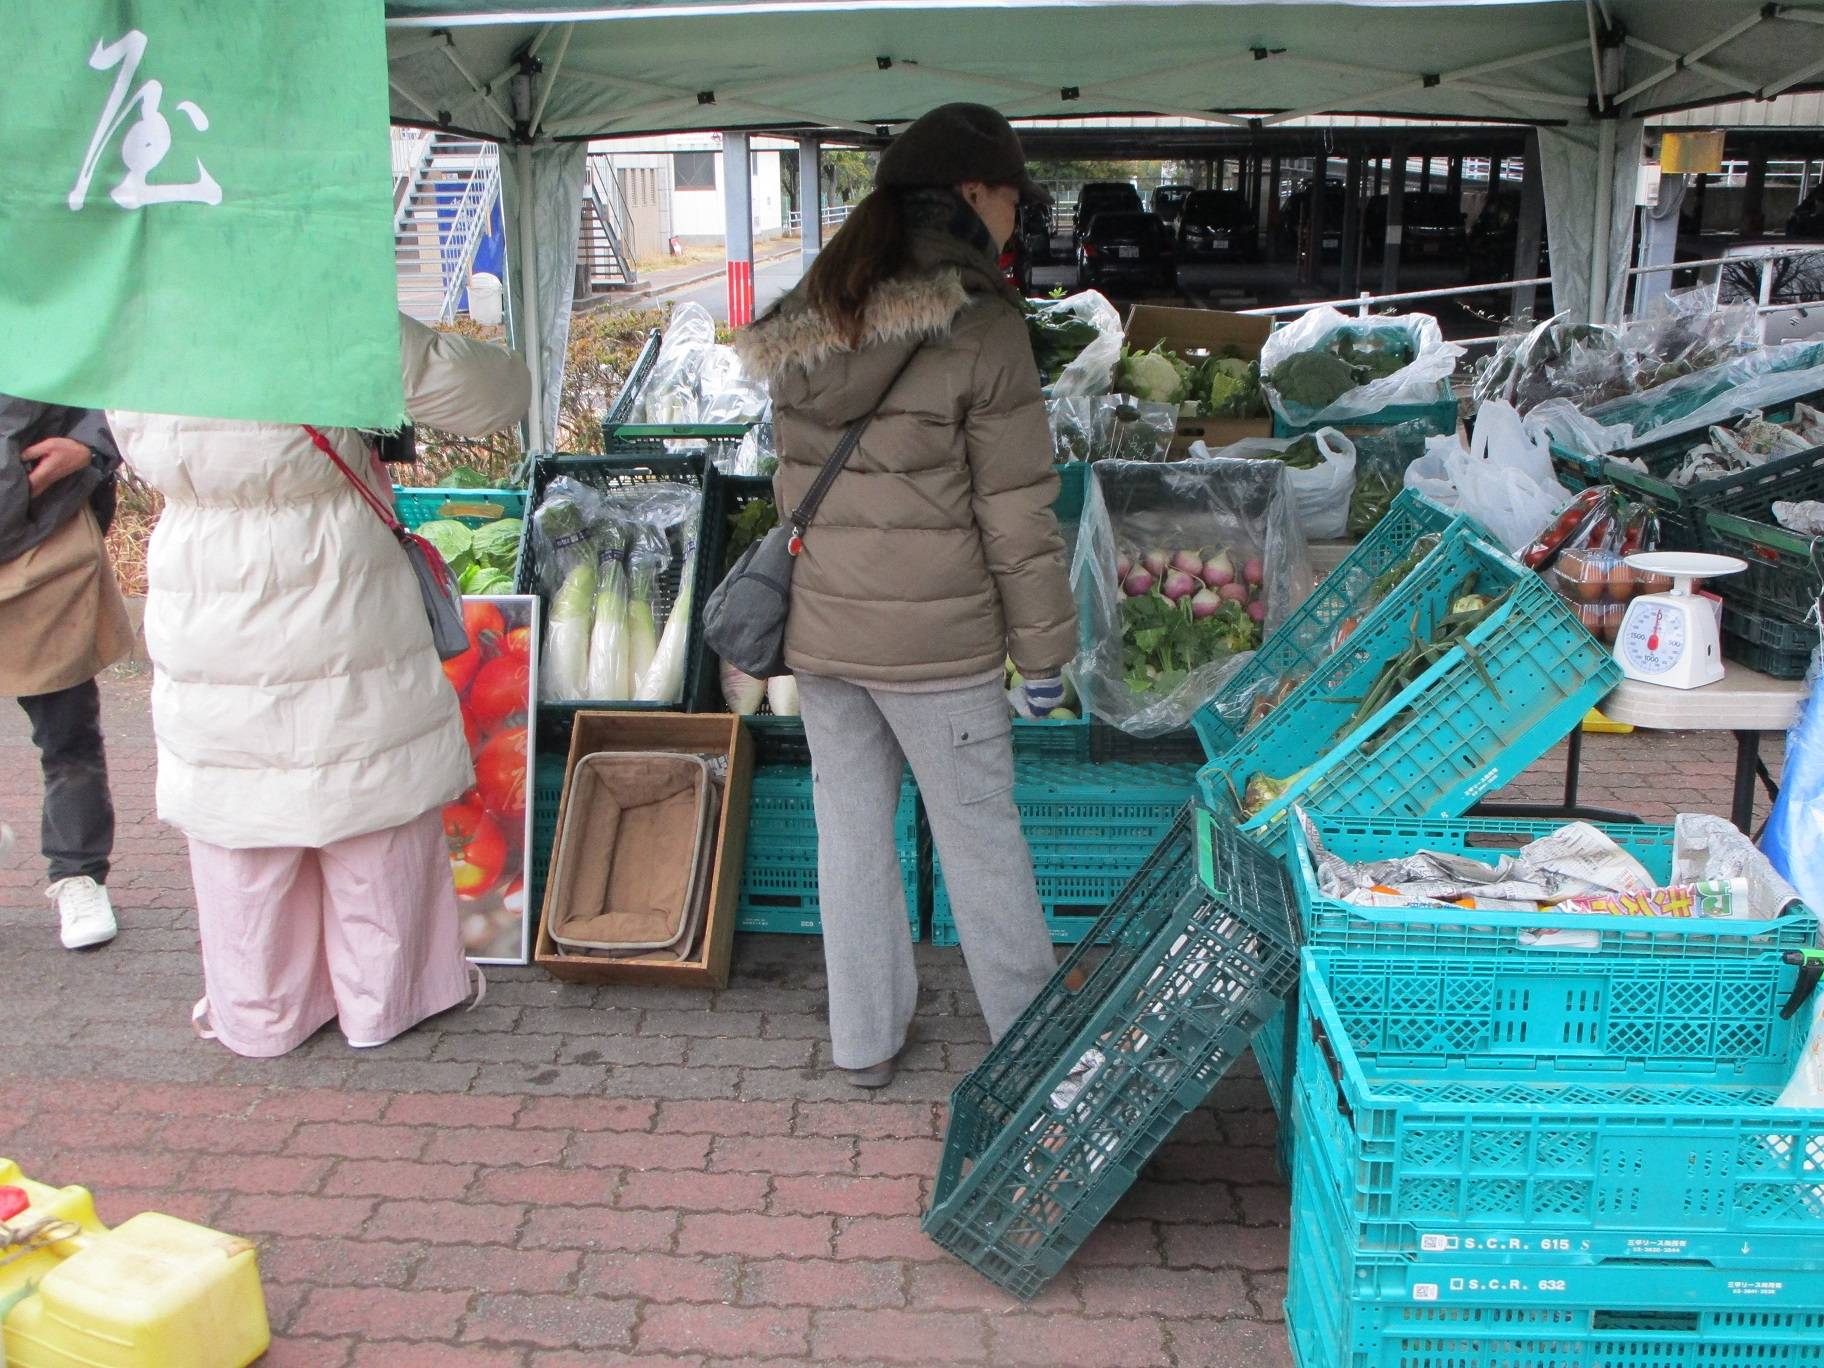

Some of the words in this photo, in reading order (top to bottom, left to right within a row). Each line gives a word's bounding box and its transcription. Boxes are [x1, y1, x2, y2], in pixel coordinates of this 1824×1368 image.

[68, 29, 223, 211] 屋
[1464, 1238, 1529, 1250] S.C.R.
[1540, 1238, 1570, 1250] 615
[1468, 1279, 1529, 1290] S.C.R.
[1538, 1279, 1566, 1290] 632
